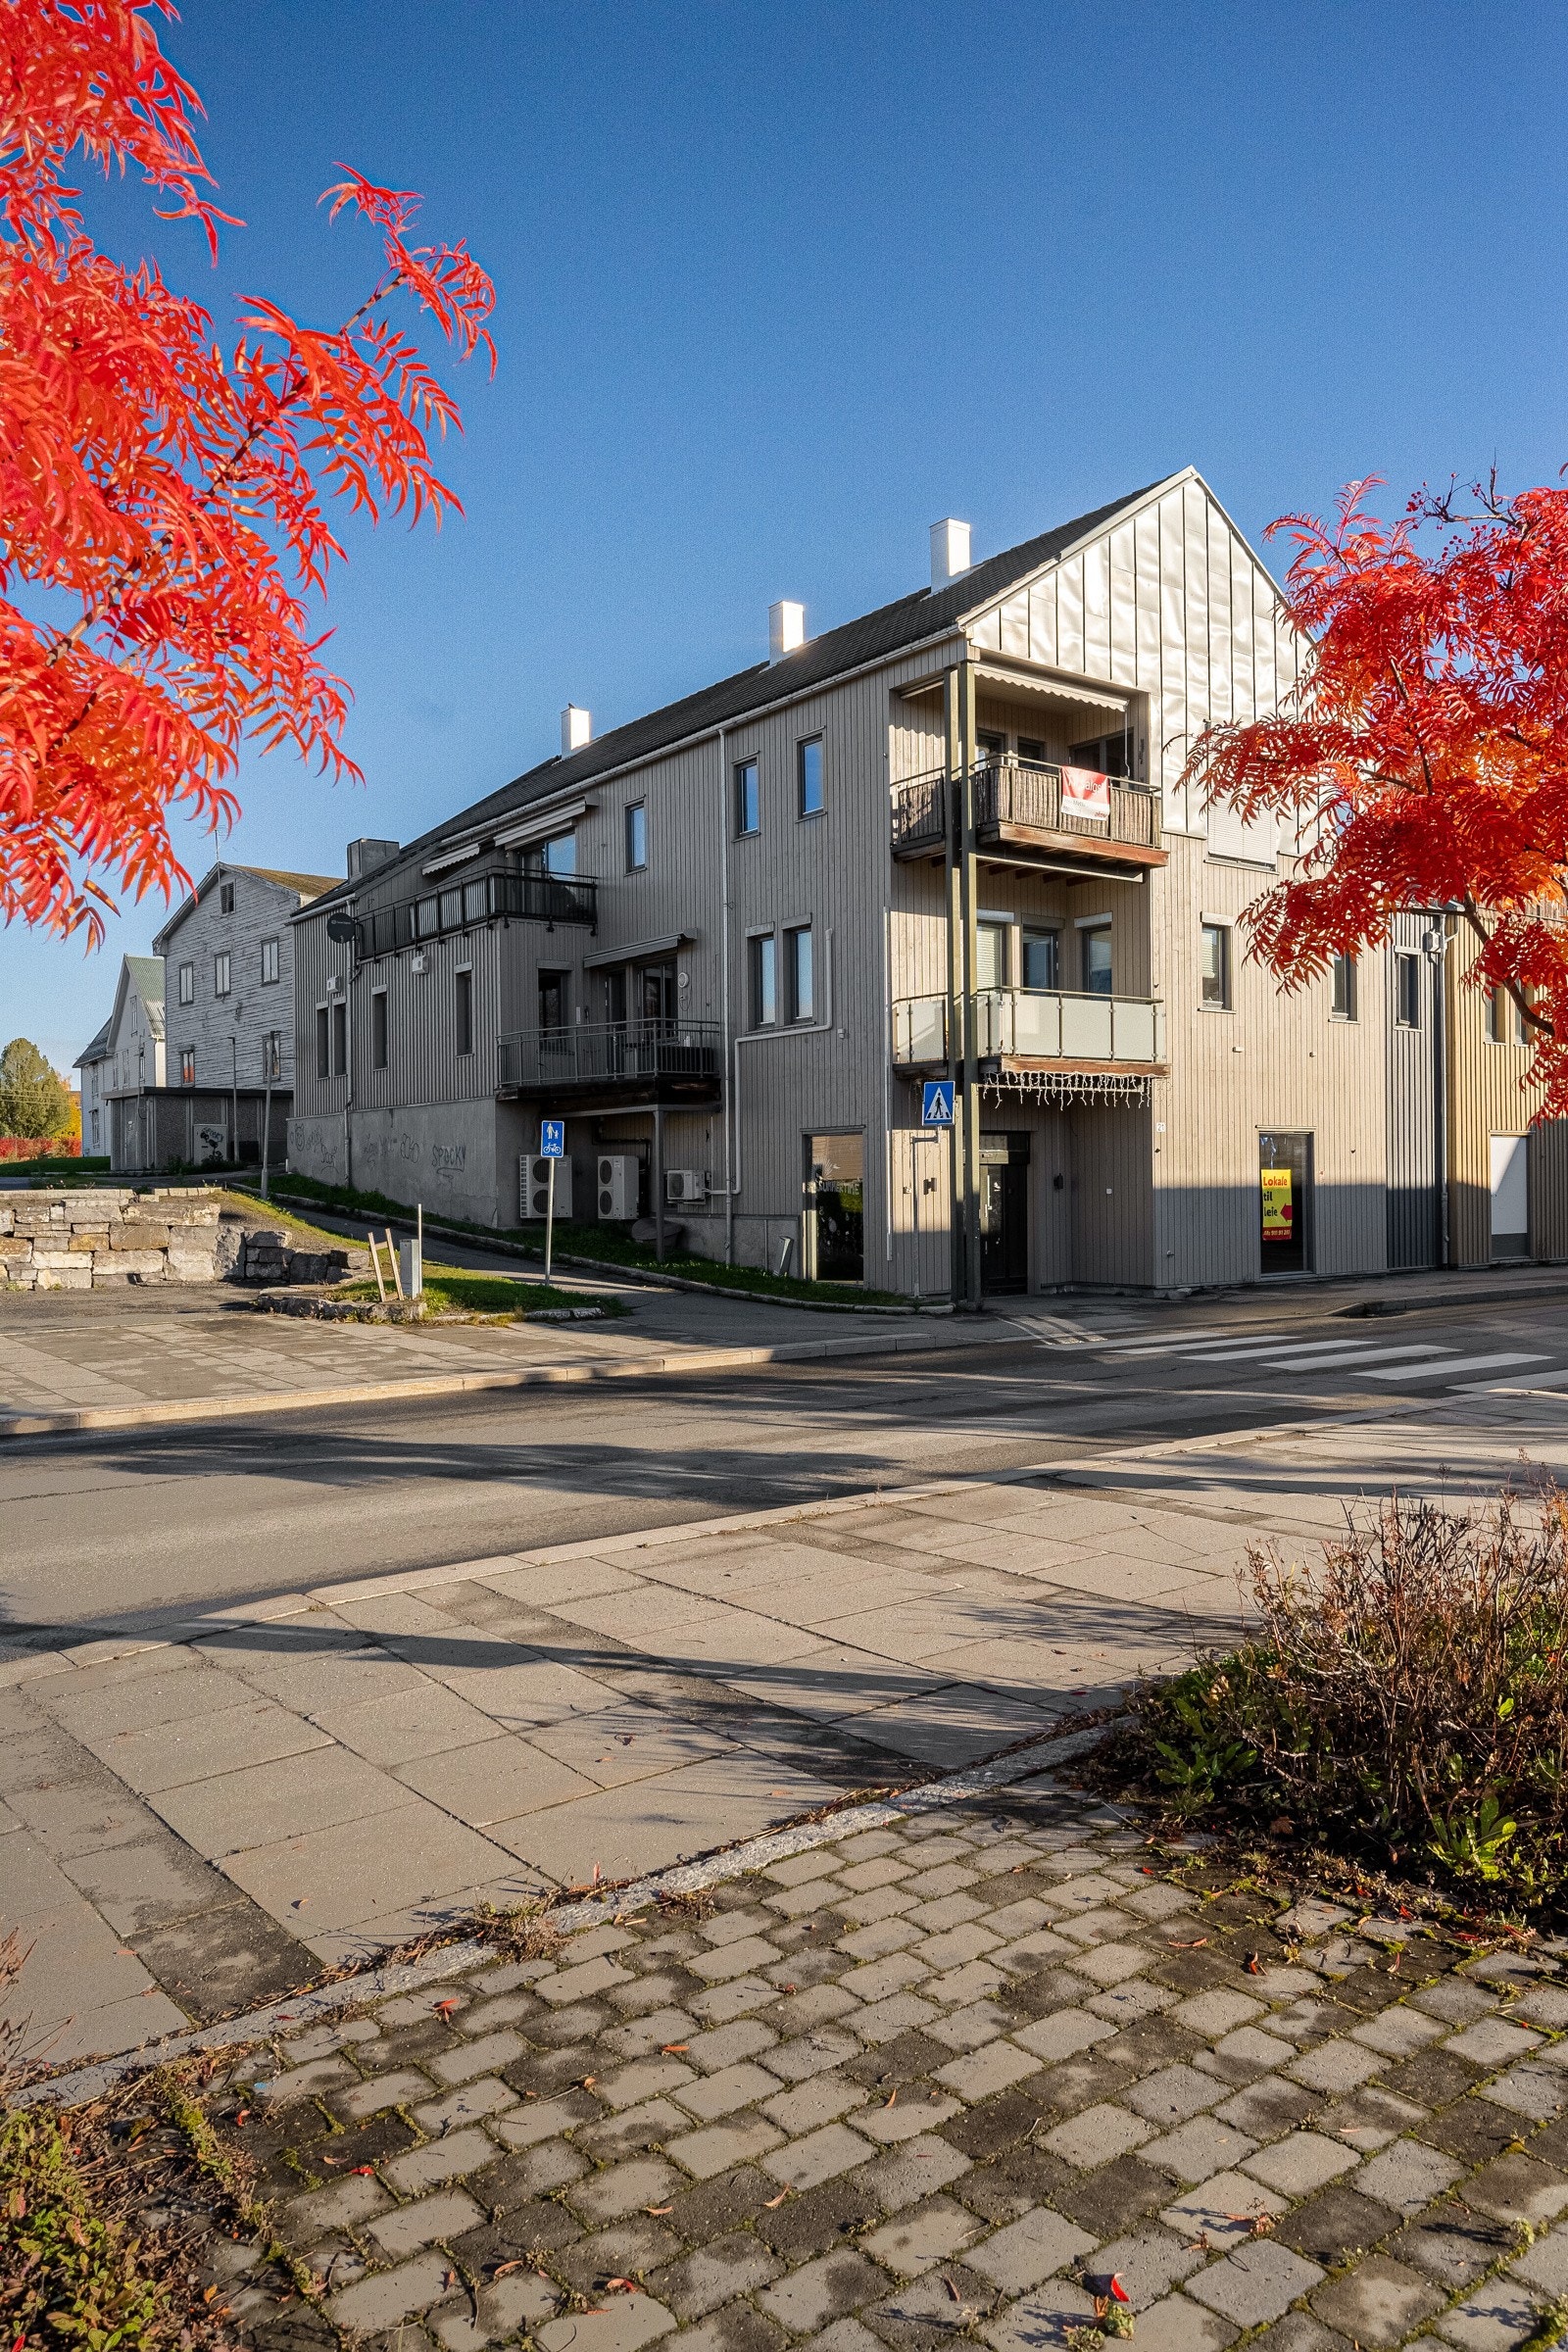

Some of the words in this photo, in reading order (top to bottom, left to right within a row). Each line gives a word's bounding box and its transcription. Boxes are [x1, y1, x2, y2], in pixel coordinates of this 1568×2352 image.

[818, 1179, 860, 1195] SUMMERTIME
[1263, 1176, 1288, 1187] Lokale
[1263, 1191, 1273, 1201] til
[1263, 1206, 1278, 1217] leie
